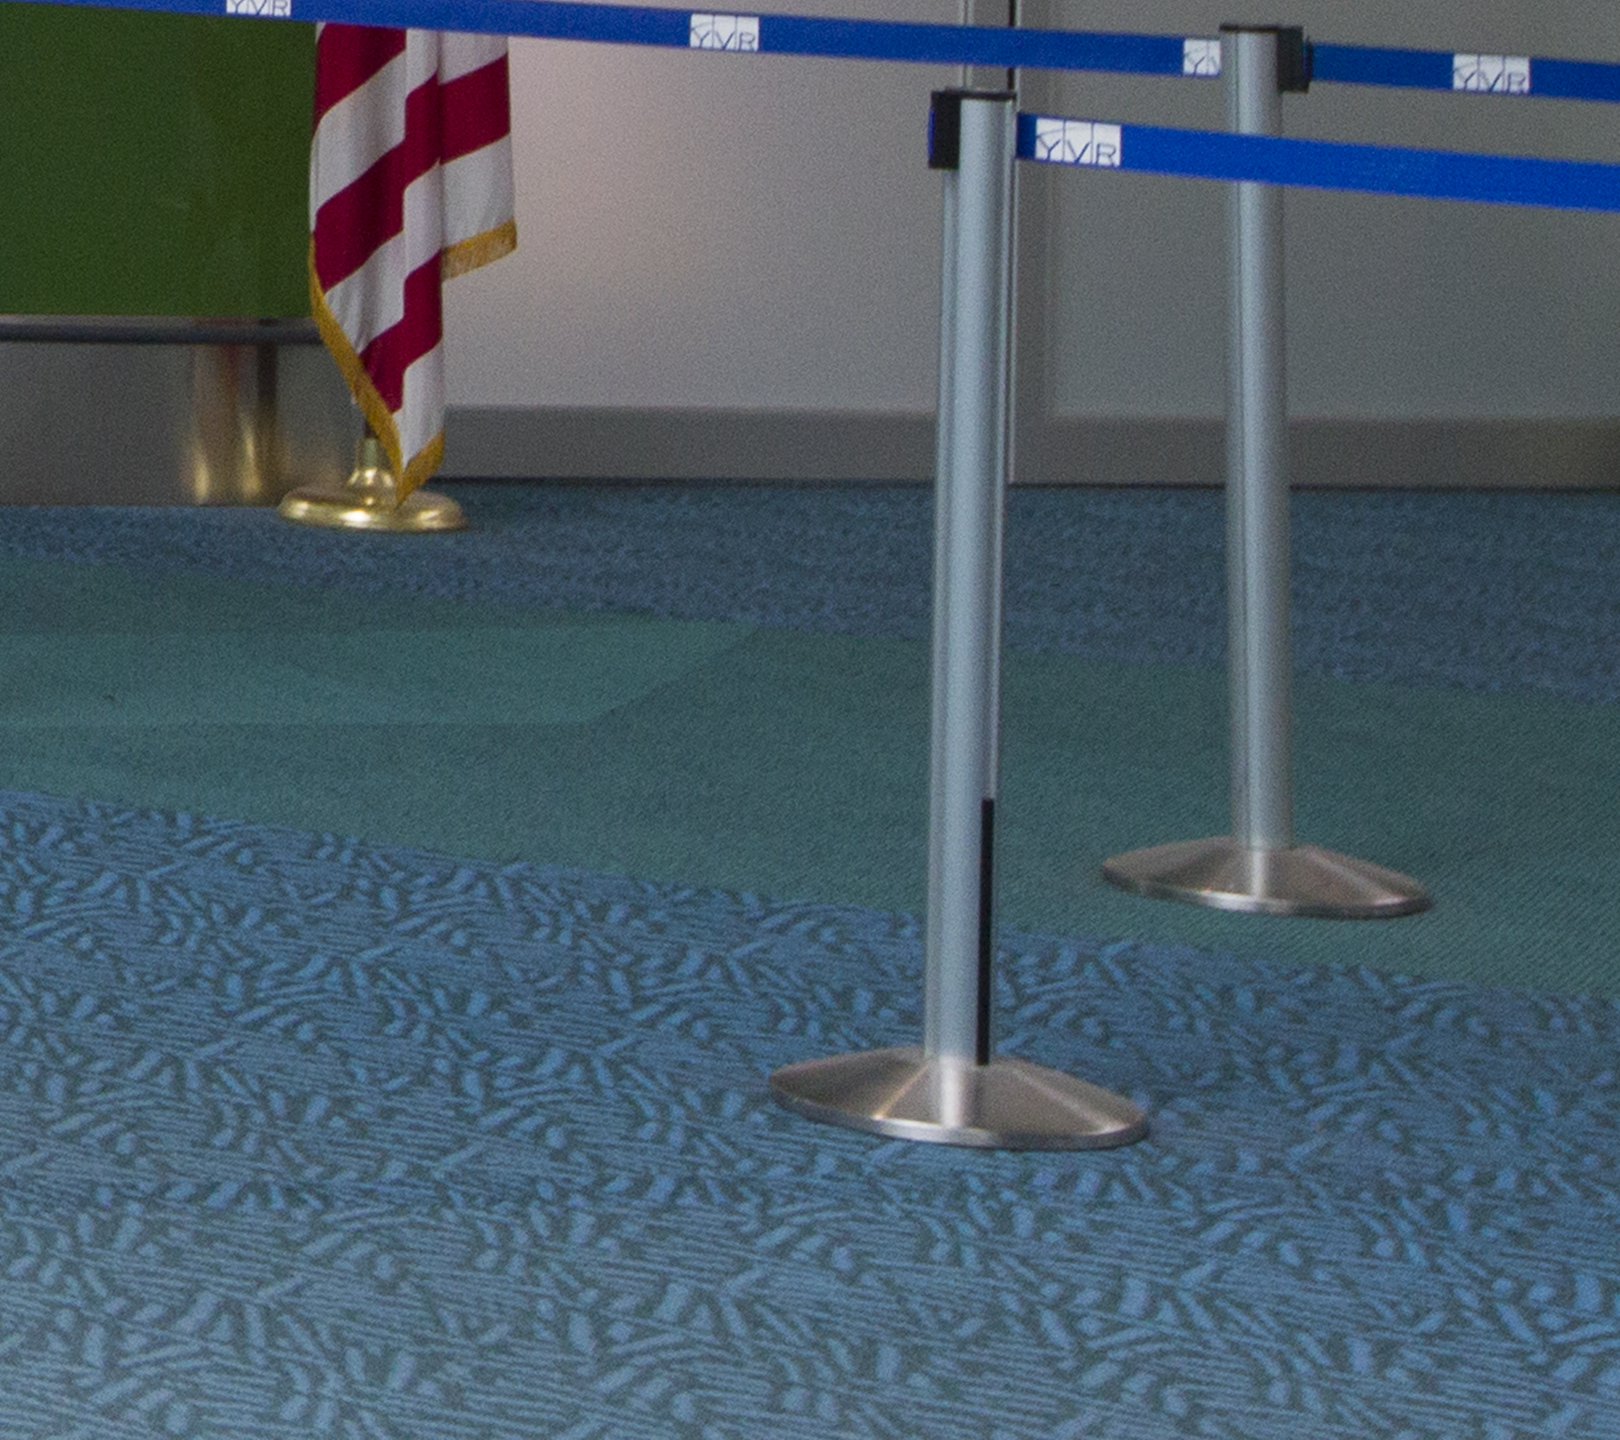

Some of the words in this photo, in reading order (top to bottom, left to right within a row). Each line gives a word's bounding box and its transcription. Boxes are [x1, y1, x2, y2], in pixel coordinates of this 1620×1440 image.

[690, 27, 757, 51] YVR
[1453, 69, 1529, 94] YVR
[1035, 132, 1119, 167] YVR
